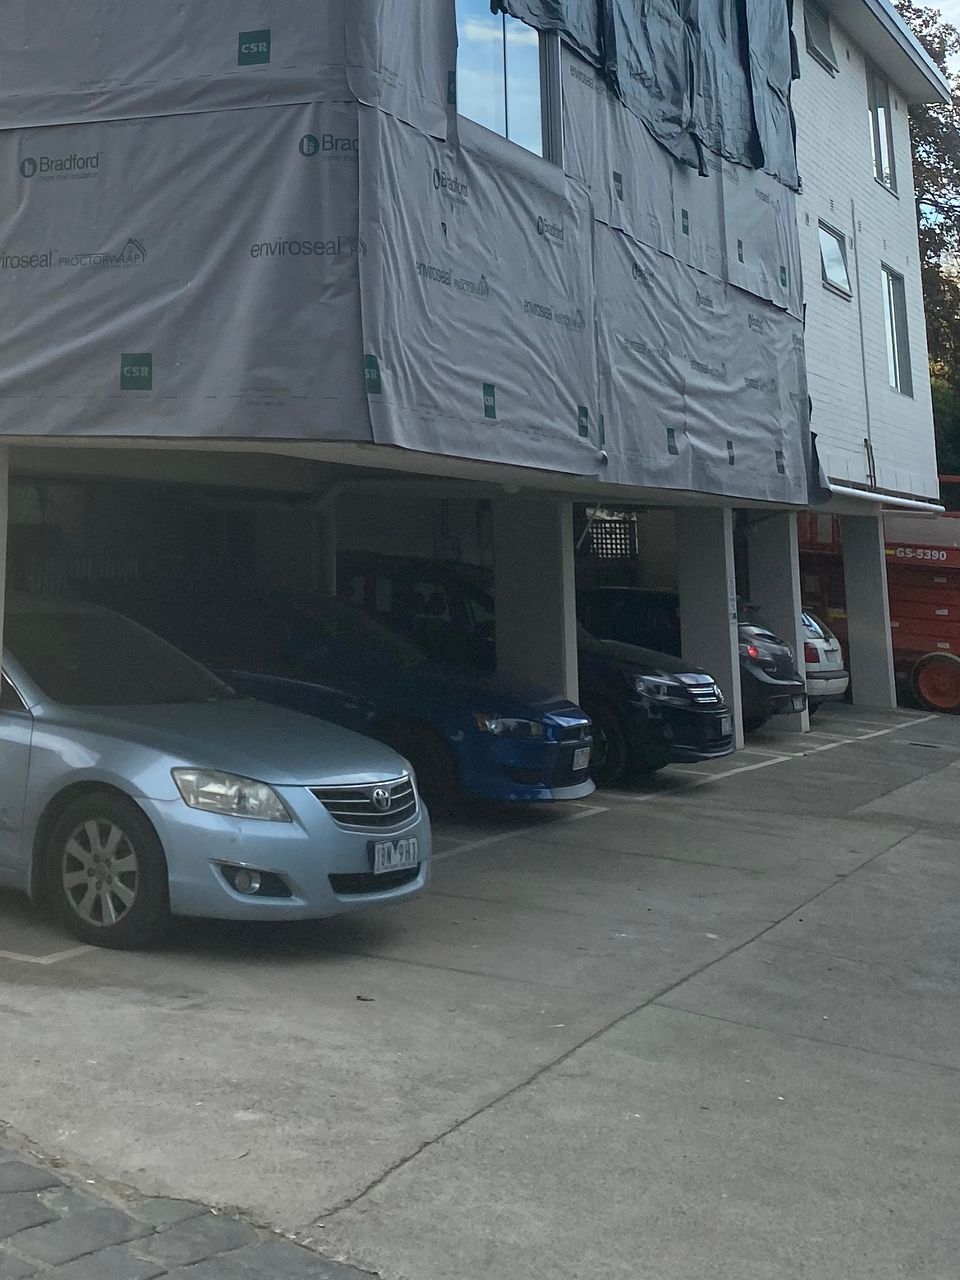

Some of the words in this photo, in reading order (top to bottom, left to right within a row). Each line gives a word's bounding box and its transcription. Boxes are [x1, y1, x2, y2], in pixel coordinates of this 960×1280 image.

[241, 41, 268, 54] CSR
[40, 152, 99, 172] Bradford
[250, 236, 340, 258] enviroseal
[123, 366, 150, 377] CSR
[896, 547, 947, 561] GS-5390
